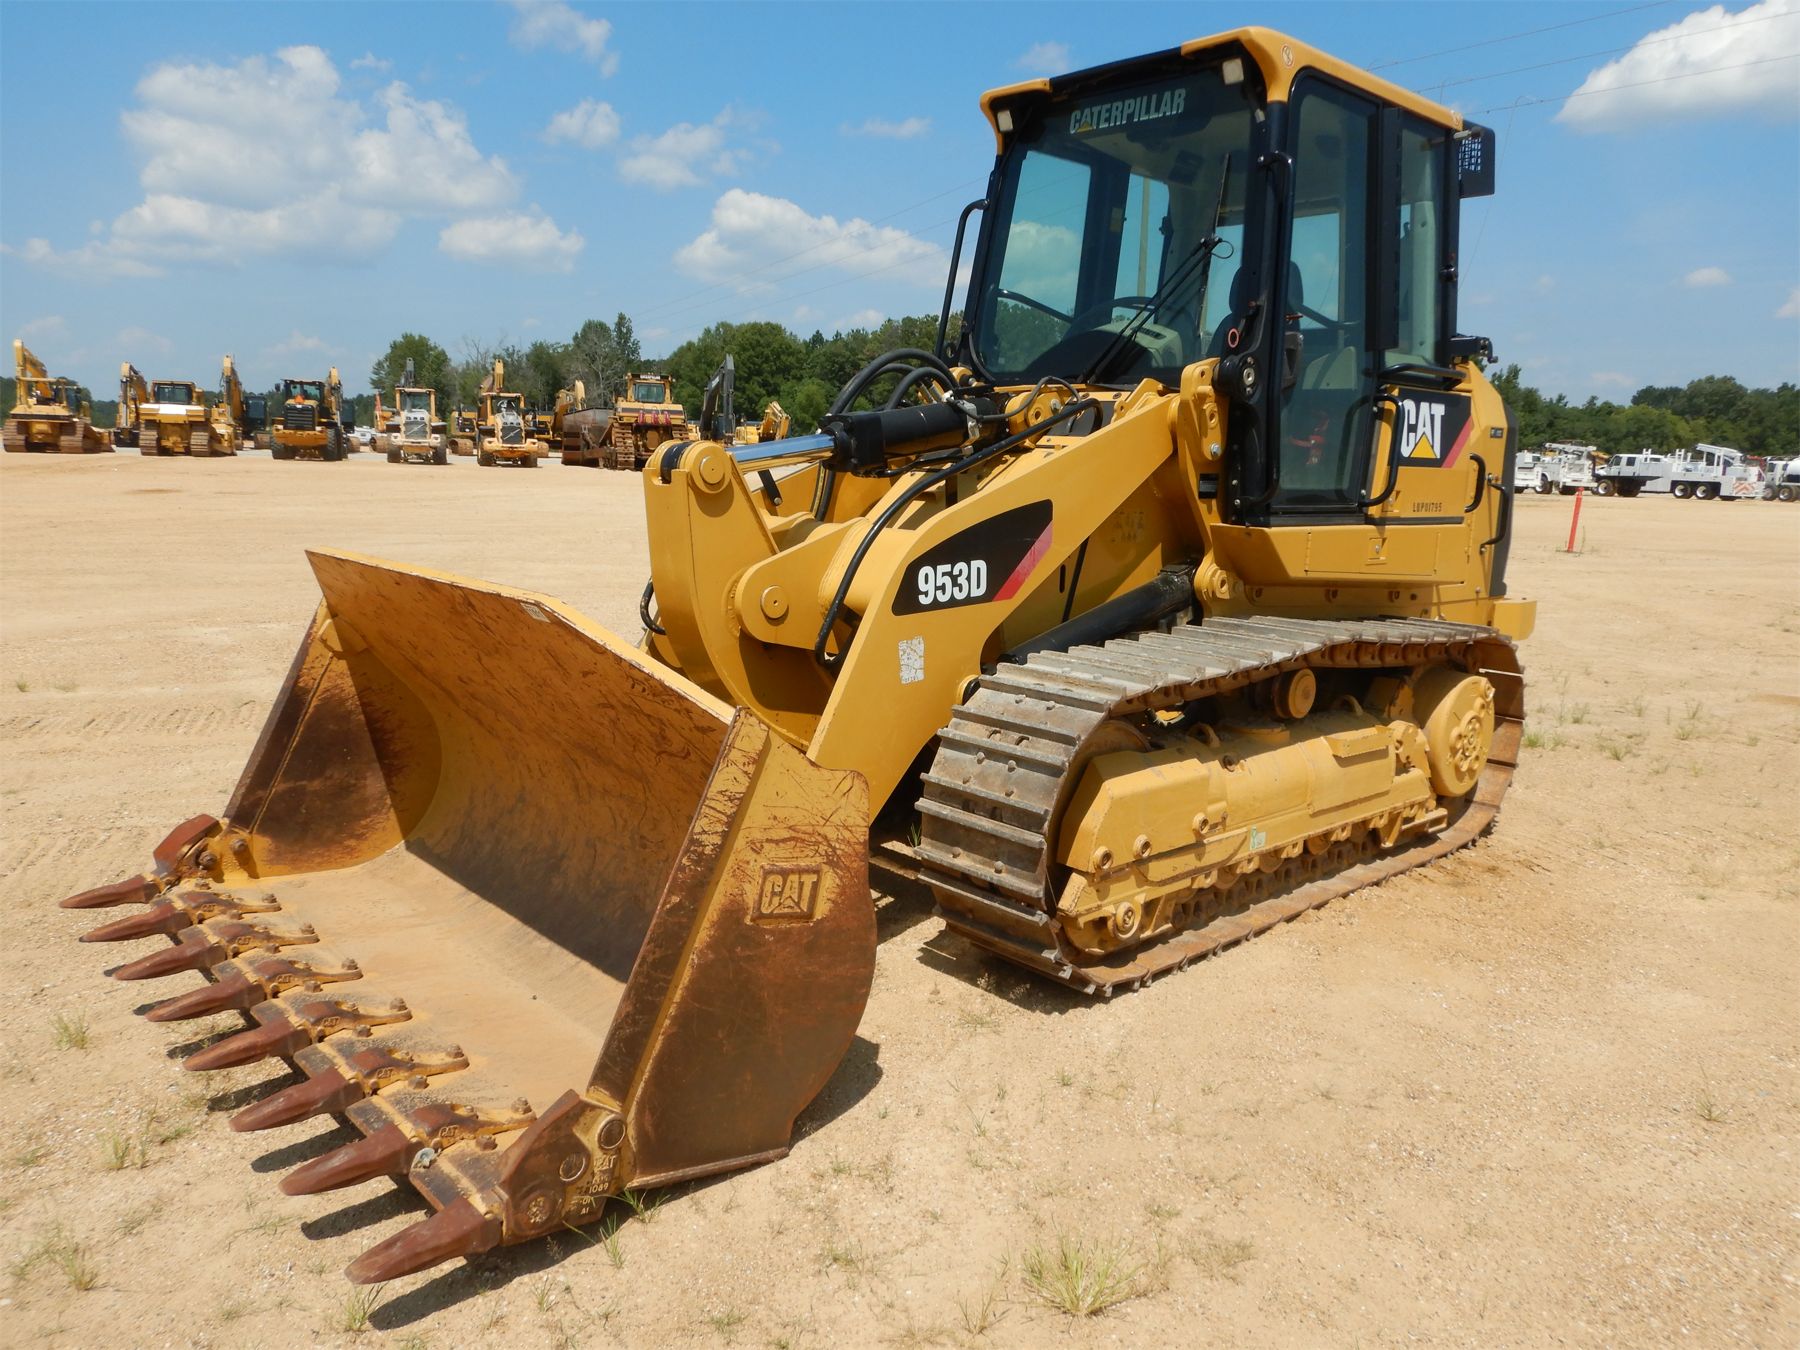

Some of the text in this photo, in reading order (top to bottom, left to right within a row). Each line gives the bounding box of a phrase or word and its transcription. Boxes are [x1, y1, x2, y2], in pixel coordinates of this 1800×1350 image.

[1069, 88, 1186, 134] CATERPILLAR
[1401, 399, 1445, 459] CAT
[917, 559, 988, 605] 953D
[760, 873, 818, 914] CAT
